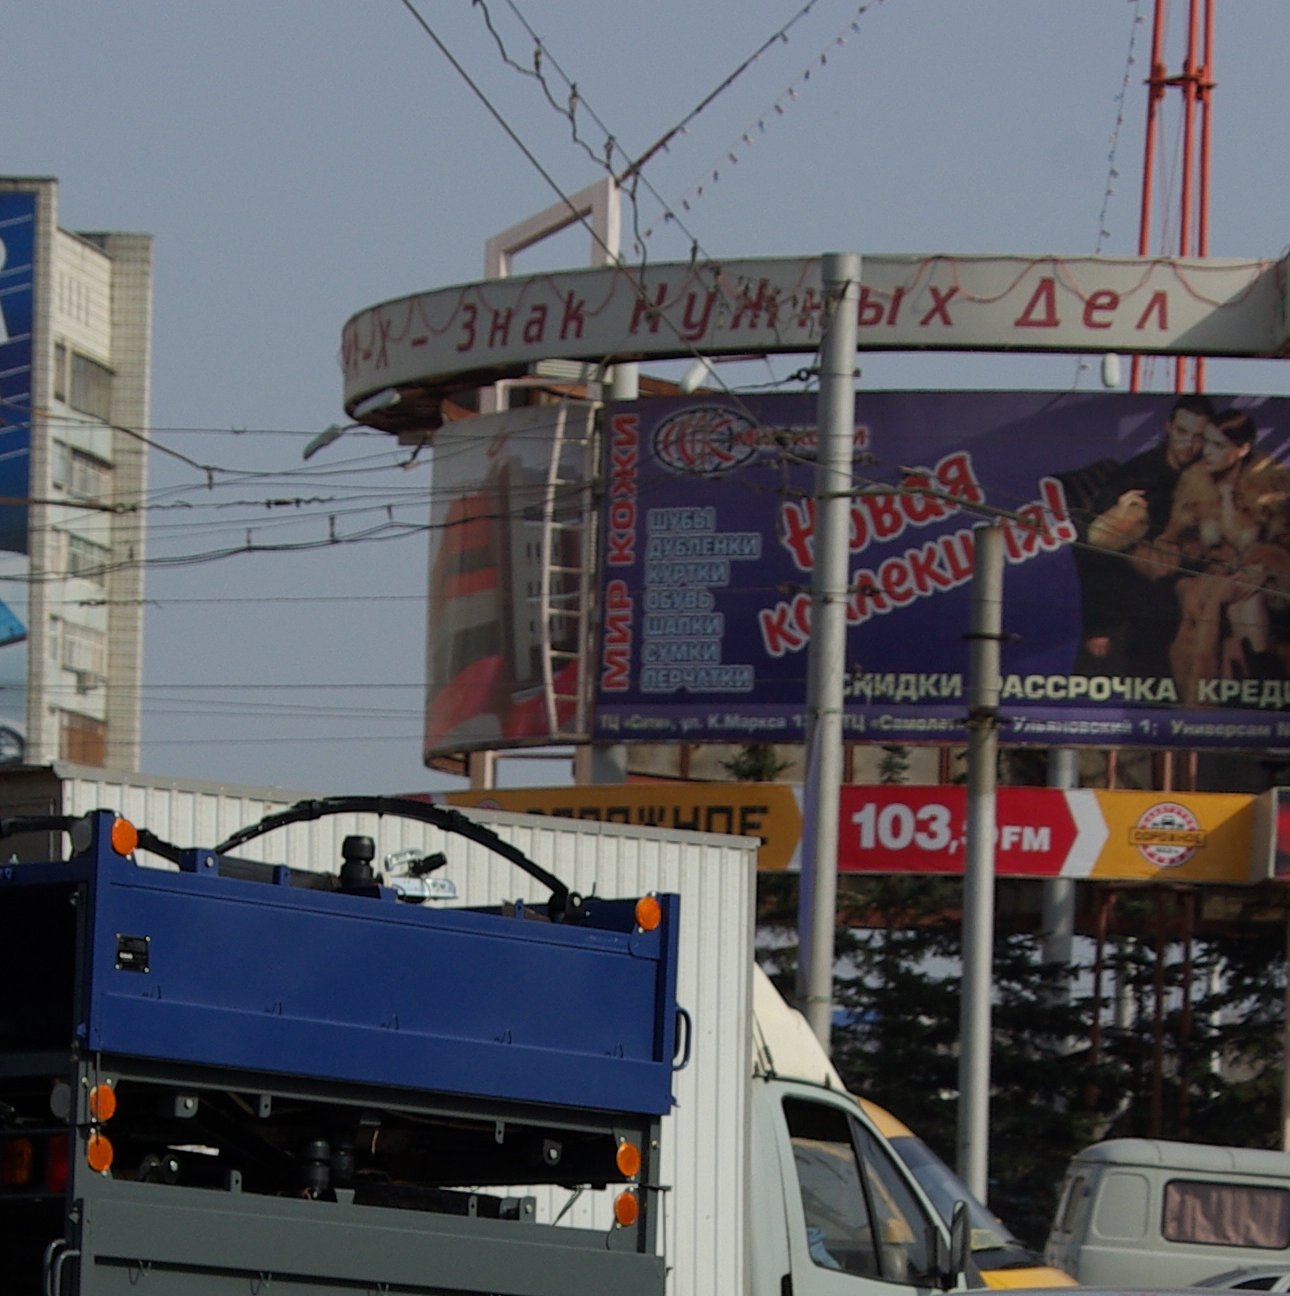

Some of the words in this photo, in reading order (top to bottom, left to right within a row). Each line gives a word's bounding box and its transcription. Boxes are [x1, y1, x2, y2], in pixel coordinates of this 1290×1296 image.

[456, 290, 585, 353] Знак
[1014, 276, 1169, 331] Дел
[609, 412, 639, 564] КОЖИ
[650, 509, 714, 531] ШУБЫ
[648, 534, 760, 559] ДУБЛЕНКИ
[647, 561, 727, 584] КУРТКИ
[603, 580, 633, 690] МИР
[646, 614, 722, 637] ШАПКИ
[644, 641, 720, 663] СУМКИ
[642, 667, 752, 690] ПЕРЧАТКИ
[842, 672, 962, 701] СКИДКИ
[526, 805, 769, 847] ЖНОЕ
[851, 803, 999, 855] 103,
[1001, 825, 1052, 853] FM
